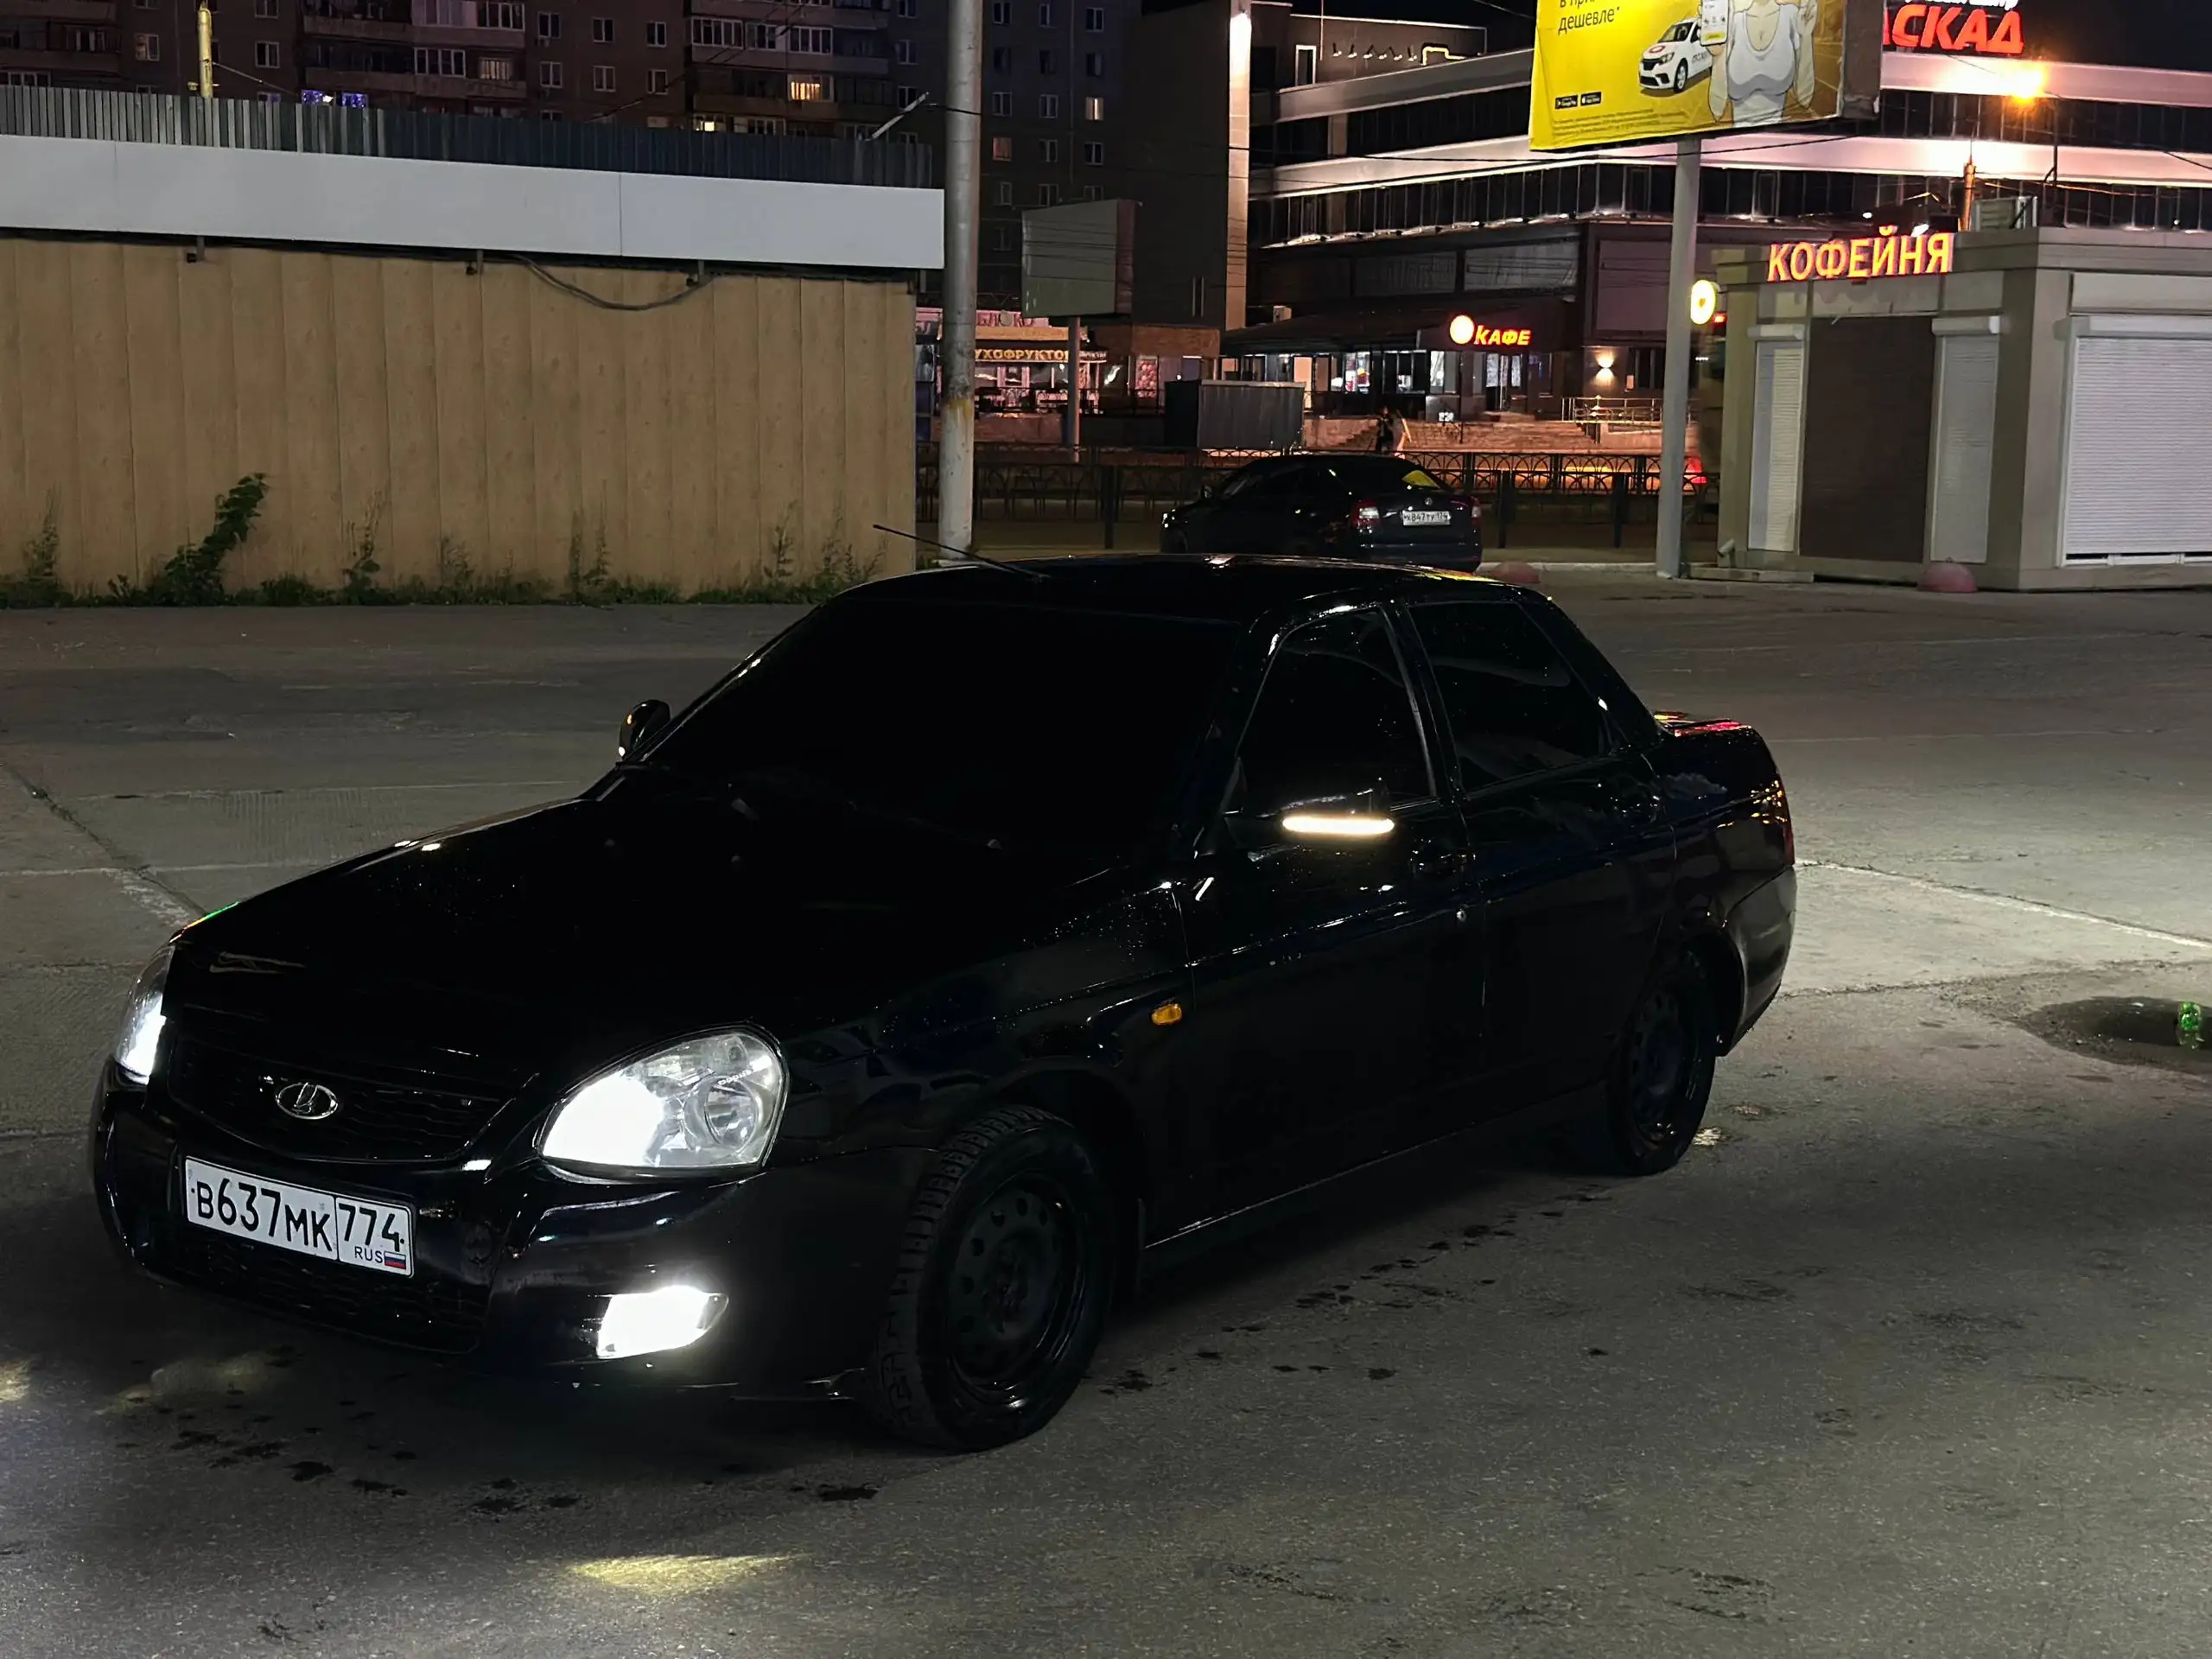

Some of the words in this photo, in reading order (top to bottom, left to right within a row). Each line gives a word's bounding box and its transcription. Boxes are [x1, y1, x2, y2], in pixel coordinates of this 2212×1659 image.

[1883, 3, 2024, 54] СКАД
[1767, 225, 1955, 283] КОФЕЙНЯ
[1473, 324, 1532, 346] КАФЕ
[196, 1179, 333, 1252] В637МК
[338, 1203, 401, 1252] 774
[354, 1246, 384, 1263] RUS
